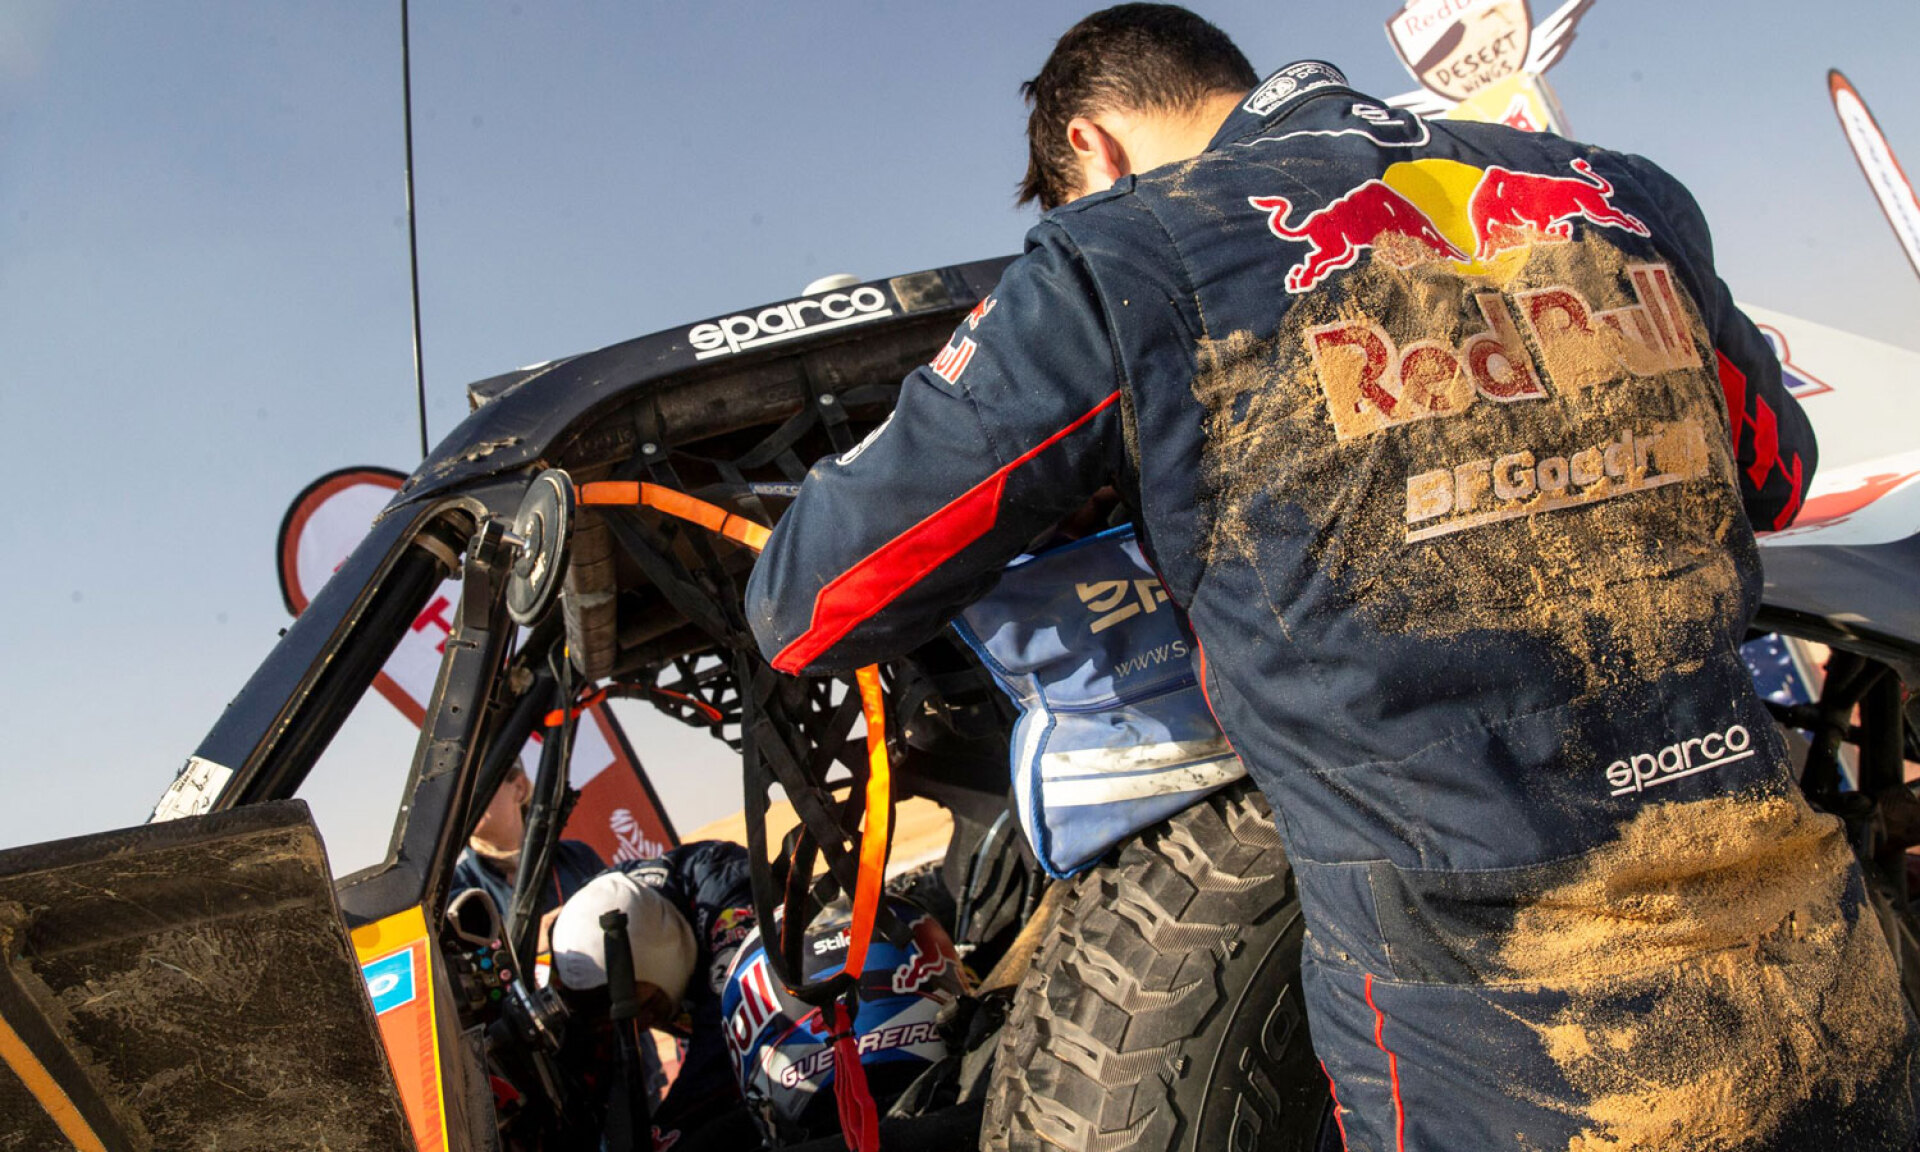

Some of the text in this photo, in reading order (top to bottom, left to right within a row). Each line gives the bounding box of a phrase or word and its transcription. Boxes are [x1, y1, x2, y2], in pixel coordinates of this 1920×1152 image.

[1436, 30, 1518, 86] DESERT
[688, 287, 889, 357] sparco
[929, 332, 977, 385] ull
[1303, 293, 1549, 441] Red
[1406, 418, 1710, 528] BFGoodr
[1606, 724, 1753, 795] sparco
[781, 1022, 942, 1089] GUEREIR
